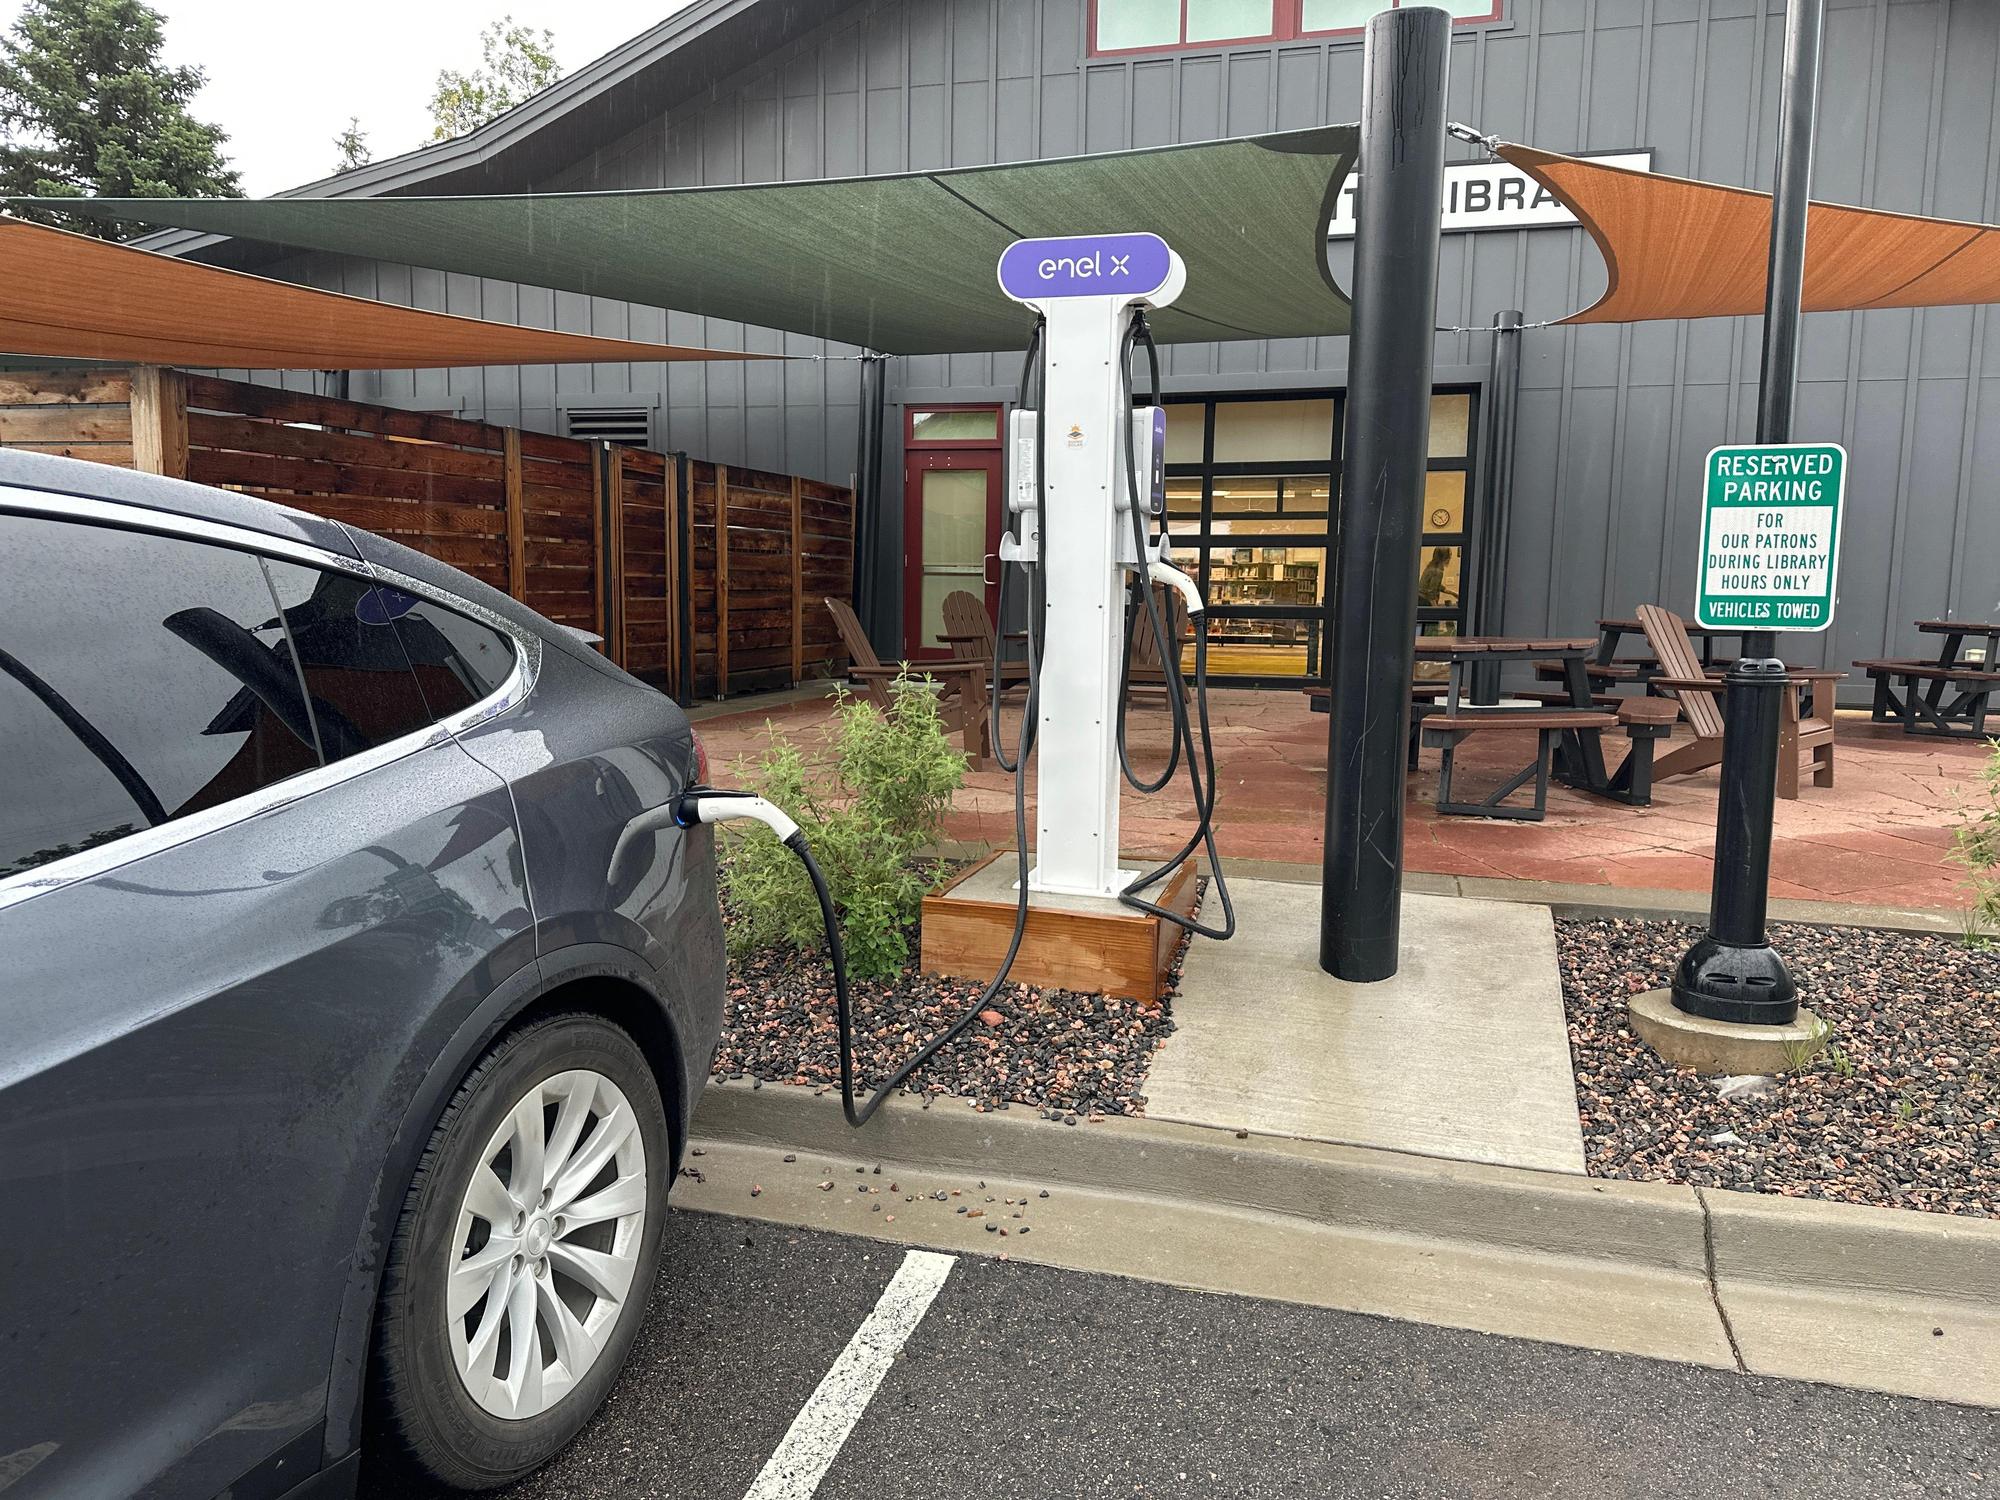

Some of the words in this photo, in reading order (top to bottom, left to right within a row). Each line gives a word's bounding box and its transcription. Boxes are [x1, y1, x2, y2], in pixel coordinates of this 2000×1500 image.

[1038, 250, 1102, 280] enel
[1717, 454, 1833, 477] RESERVED
[1723, 480, 1823, 502] PARKING
[1757, 513, 1784, 528] FOR
[1721, 534, 1749, 549] OUR
[1755, 534, 1818, 549] PATRONS
[1709, 554, 1761, 569] DURING
[1767, 554, 1827, 570] LIBRARY
[1721, 575, 1768, 590] HOURS
[1773, 575, 1811, 590] ONLY
[1709, 601, 1771, 618] VEHICLES
[1776, 603, 1820, 619] TOWED
